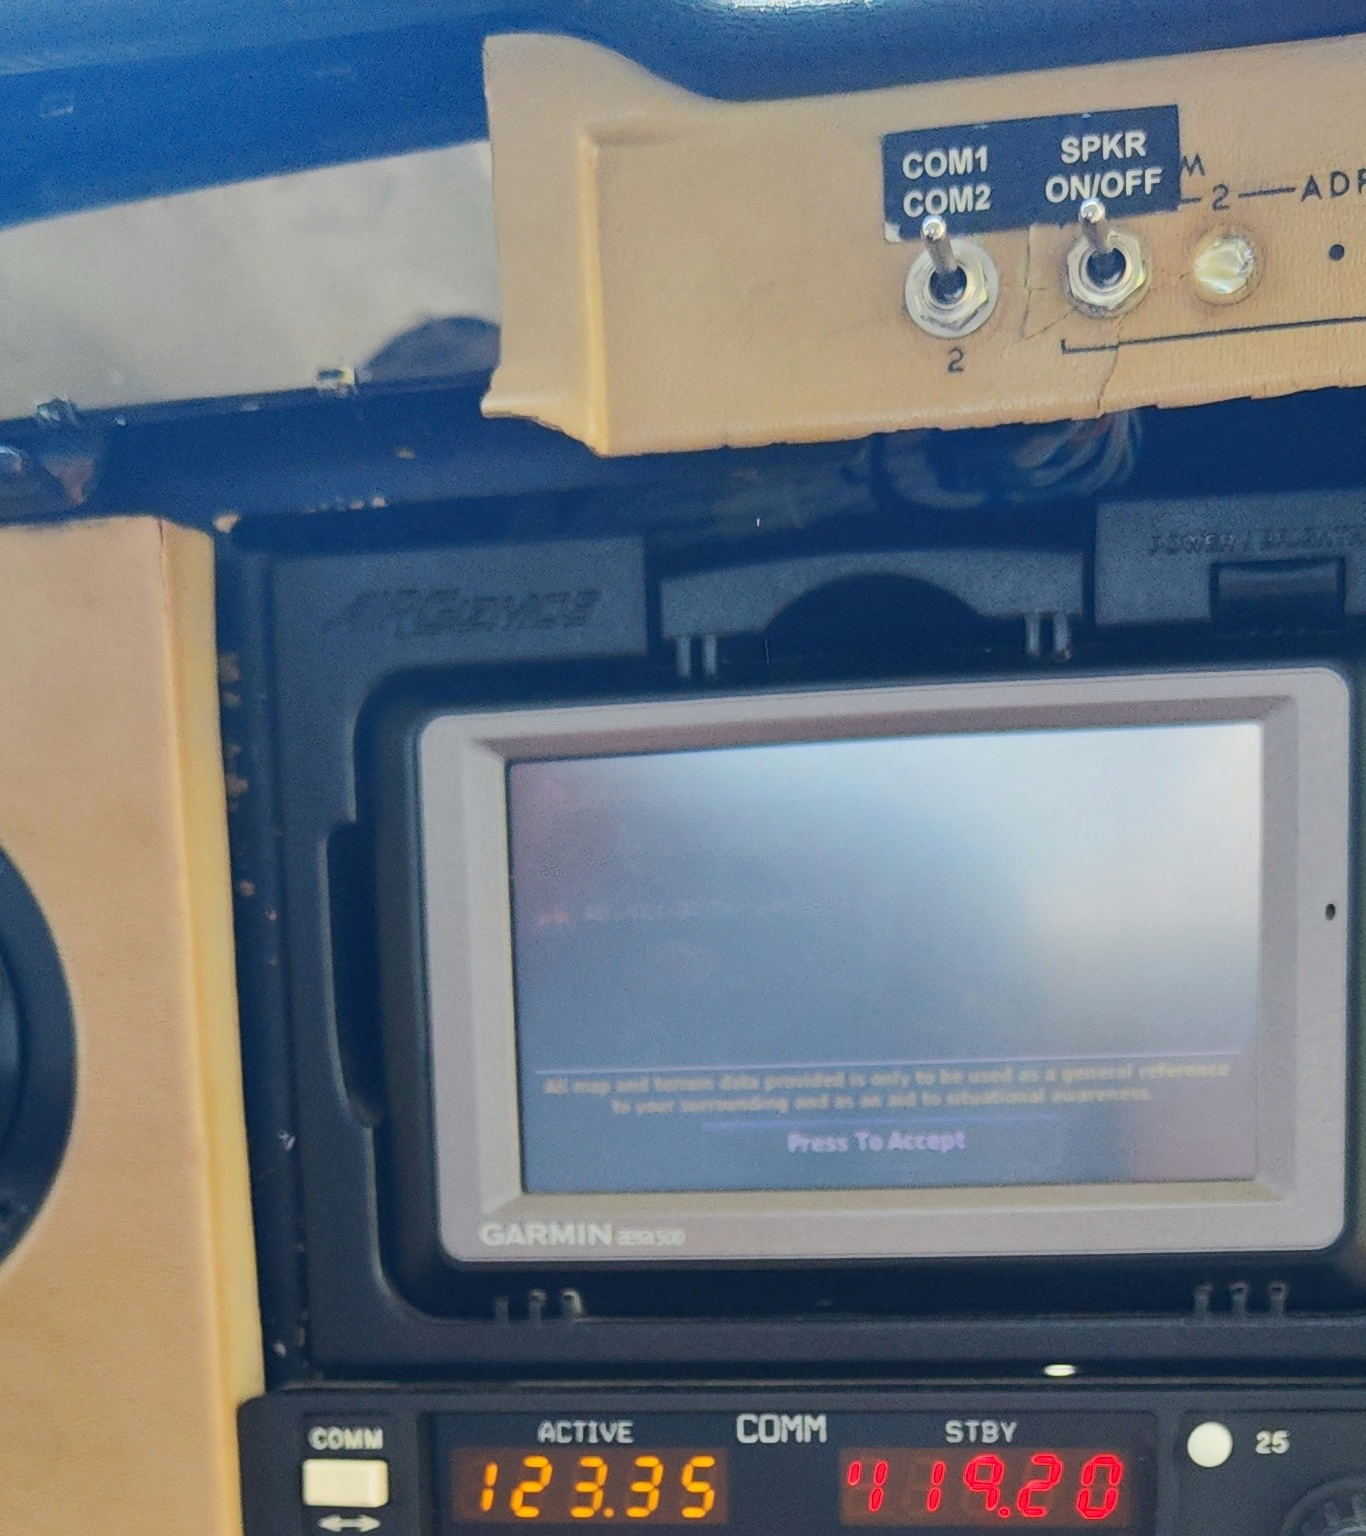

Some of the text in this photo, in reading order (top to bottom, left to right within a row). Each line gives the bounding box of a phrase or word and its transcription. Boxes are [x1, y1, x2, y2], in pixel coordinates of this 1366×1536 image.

[901, 143, 990, 181] COM1
[1059, 130, 1148, 166] SPKR
[1044, 165, 1165, 206] ON/OFF
[1211, 184, 1232, 213] 2
[902, 185, 993, 219] COM2
[947, 347, 966, 375] 2
[786, 1129, 966, 1154] Press To Accept
[478, 1221, 614, 1248] GARMIN
[308, 1427, 384, 1452] COMM
[537, 1420, 635, 1445] ACTIVE
[736, 1413, 829, 1445] COMM
[944, 1420, 1019, 1445] STBY
[1253, 1430, 1291, 1456] 25
[479, 1454, 718, 1520] 123.35
